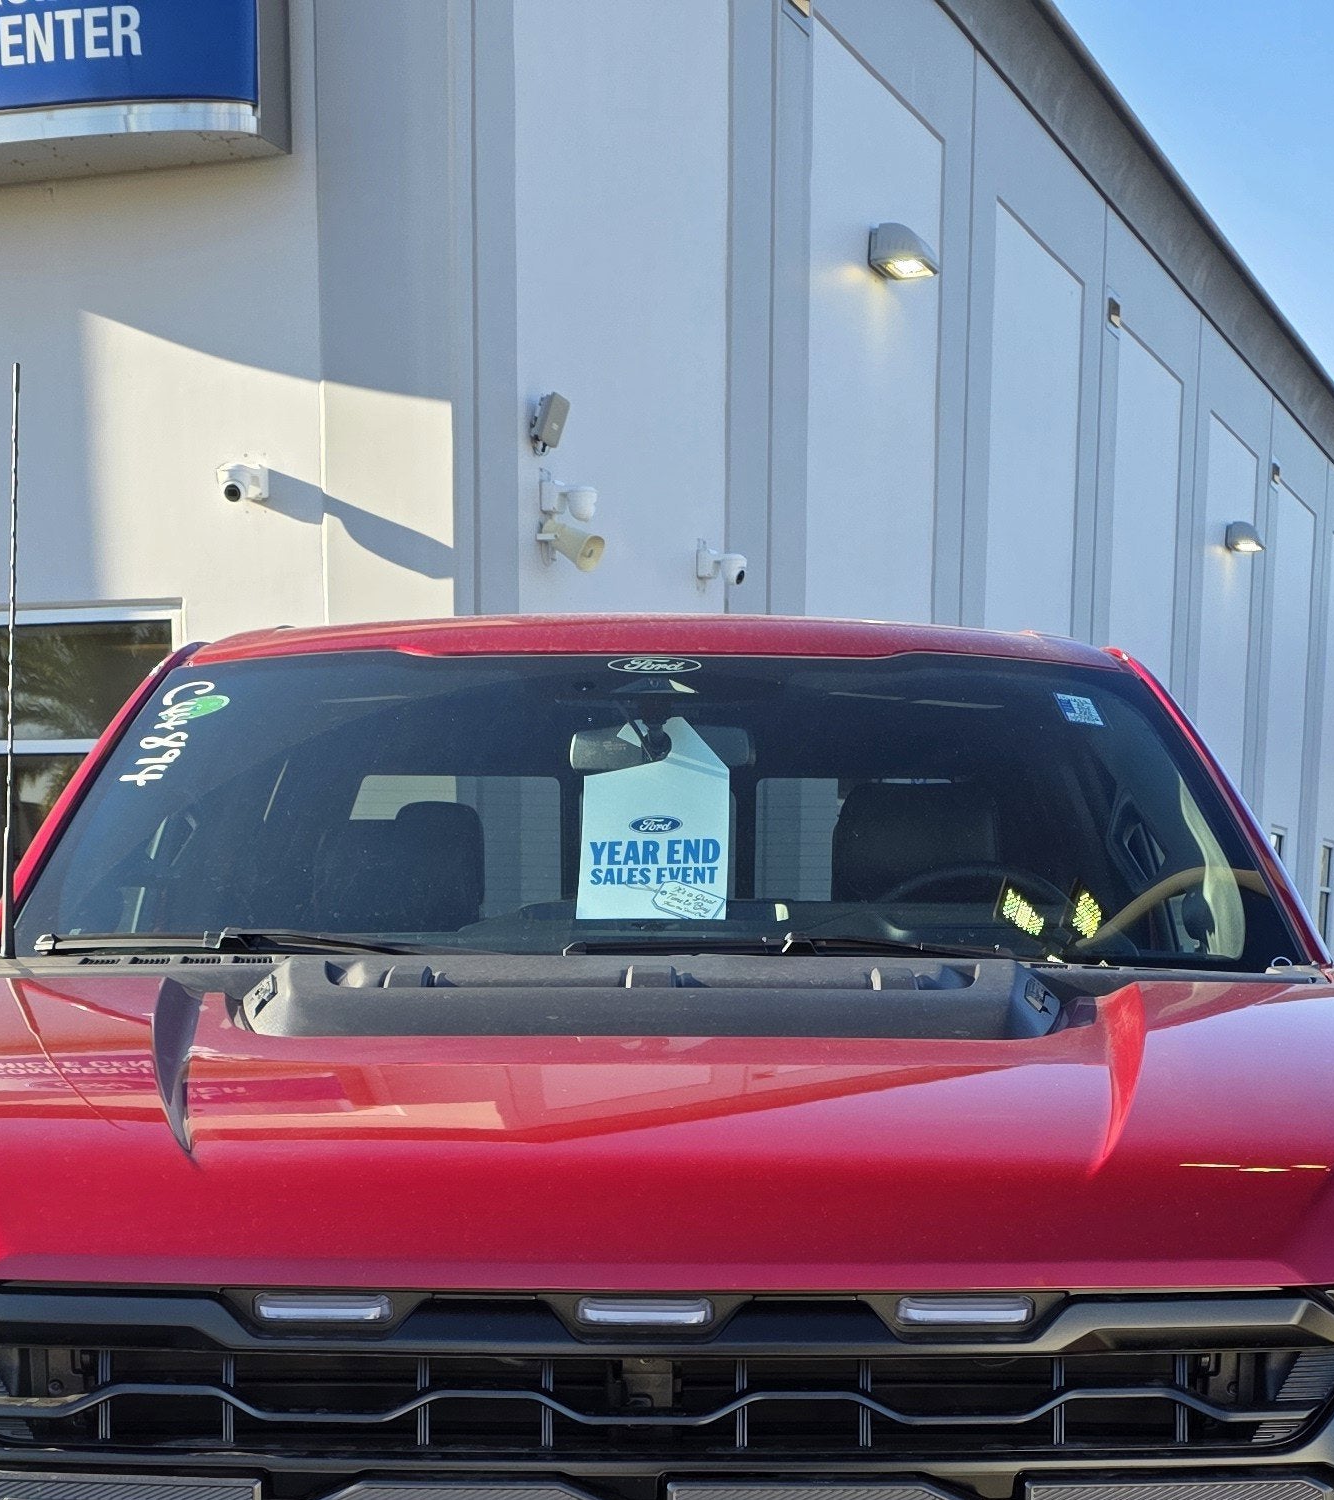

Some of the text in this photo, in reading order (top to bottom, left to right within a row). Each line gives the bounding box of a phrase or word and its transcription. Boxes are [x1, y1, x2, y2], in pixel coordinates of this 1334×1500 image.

[624, 658, 686, 671] Ford
[590, 838, 720, 866] YEAR END
[590, 866, 719, 886] SALES EVENT
